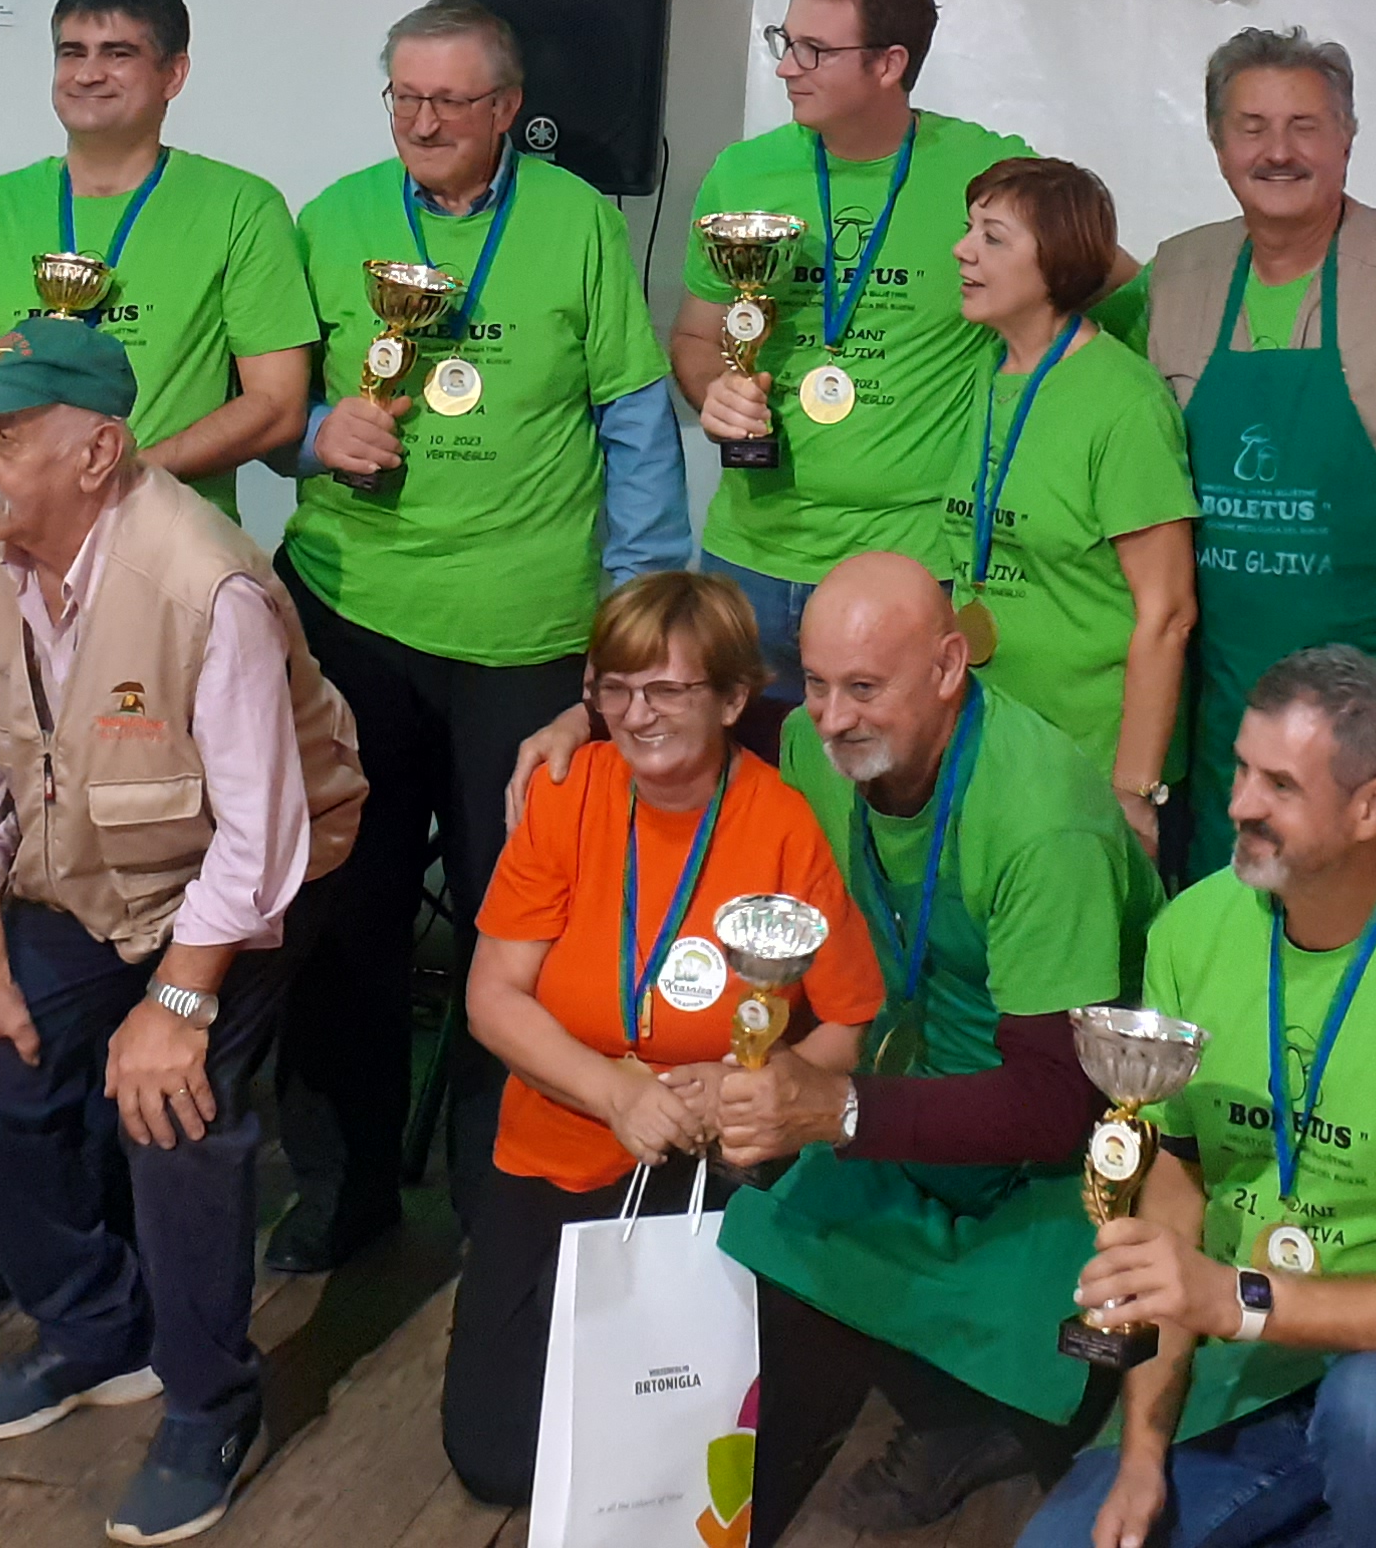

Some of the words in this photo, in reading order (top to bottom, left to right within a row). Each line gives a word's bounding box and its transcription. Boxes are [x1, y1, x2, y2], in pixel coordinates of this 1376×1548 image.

[793, 266, 909, 285] BOEUS
[1202, 495, 1315, 521] BOLETUS
[1195, 547, 1238, 571] ANI
[1245, 550, 1333, 575] GLJIVA
[1228, 1101, 1352, 1149] BOETUS
[635, 1373, 702, 1395] BRTONIGLA
